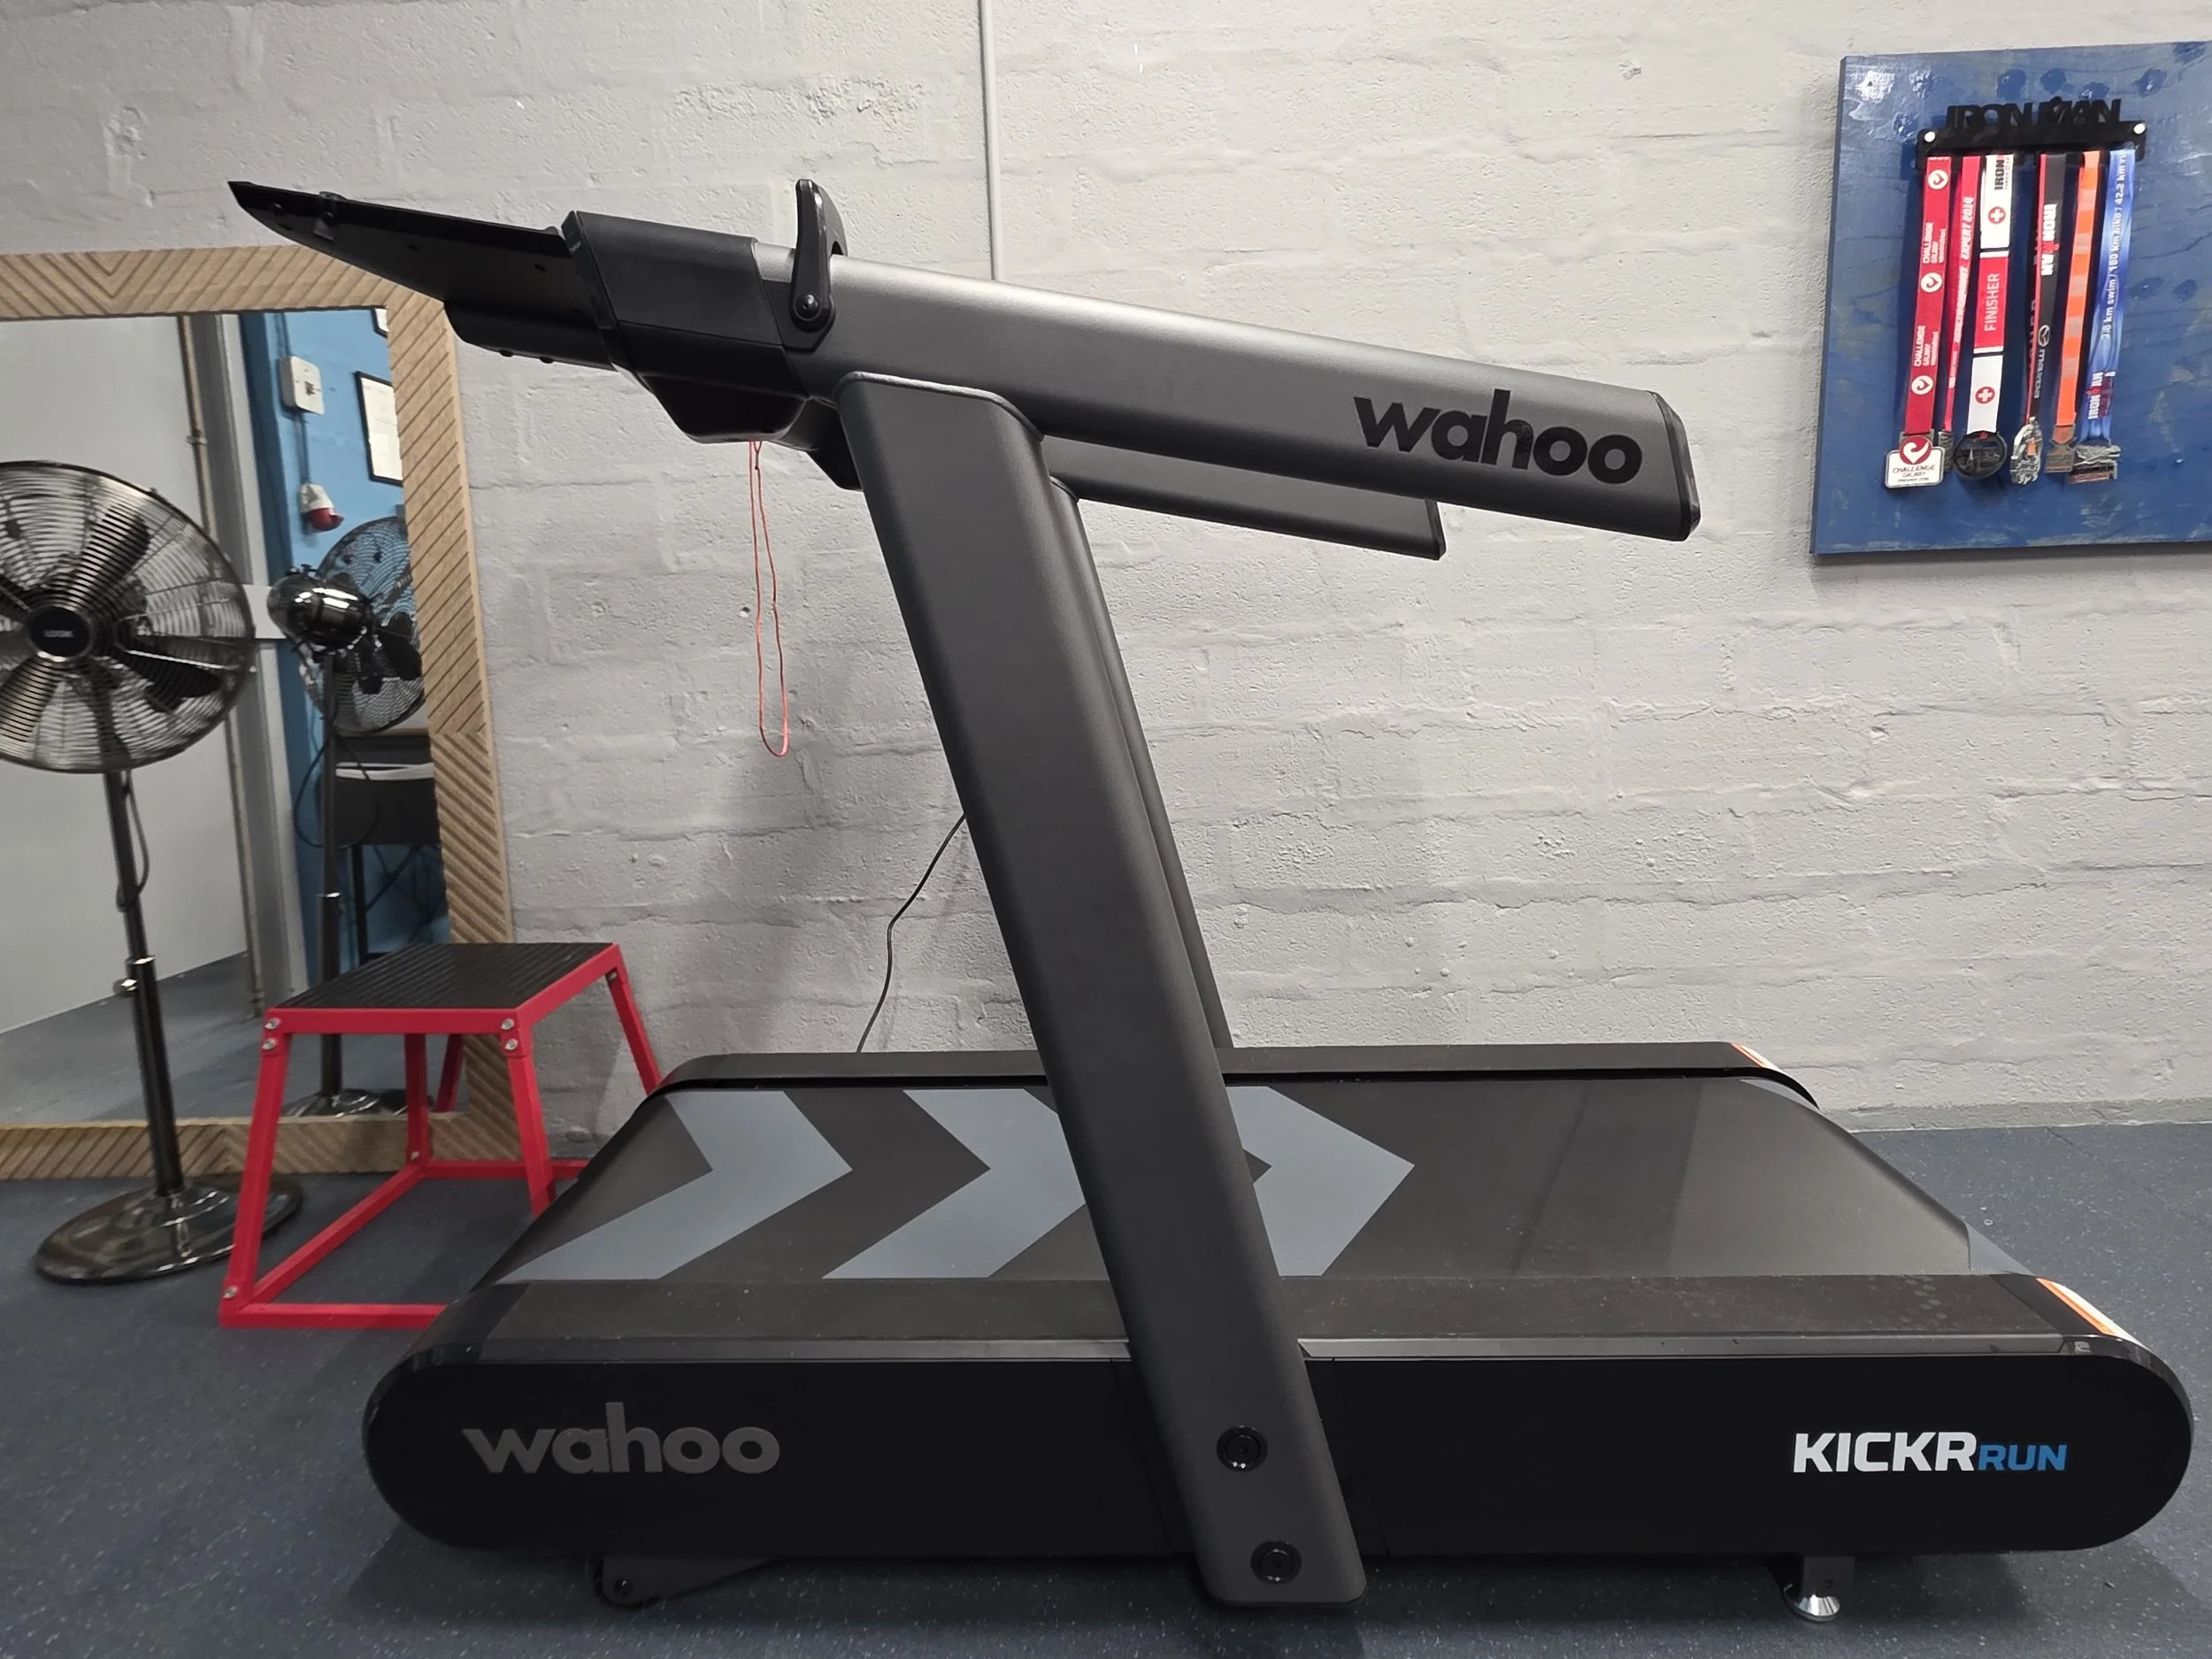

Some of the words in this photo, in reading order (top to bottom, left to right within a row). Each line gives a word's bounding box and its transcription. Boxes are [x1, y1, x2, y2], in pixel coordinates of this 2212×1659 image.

[1962, 222, 1973, 260] EXPERT
[2111, 234, 2120, 251] km
[1985, 273, 2000, 332] FINISHER
[2106, 279, 2116, 304] swim
[2104, 306, 2113, 322] km
[2034, 349, 2046, 398] mazda
[1353, 388, 1643, 485] wahoo
[1893, 465, 1936, 473] CHALLENGE
[461, 1402, 780, 1474] wahoo
[1793, 1432, 1977, 1473] KICKR
[1978, 1444, 2068, 1471] RUN
